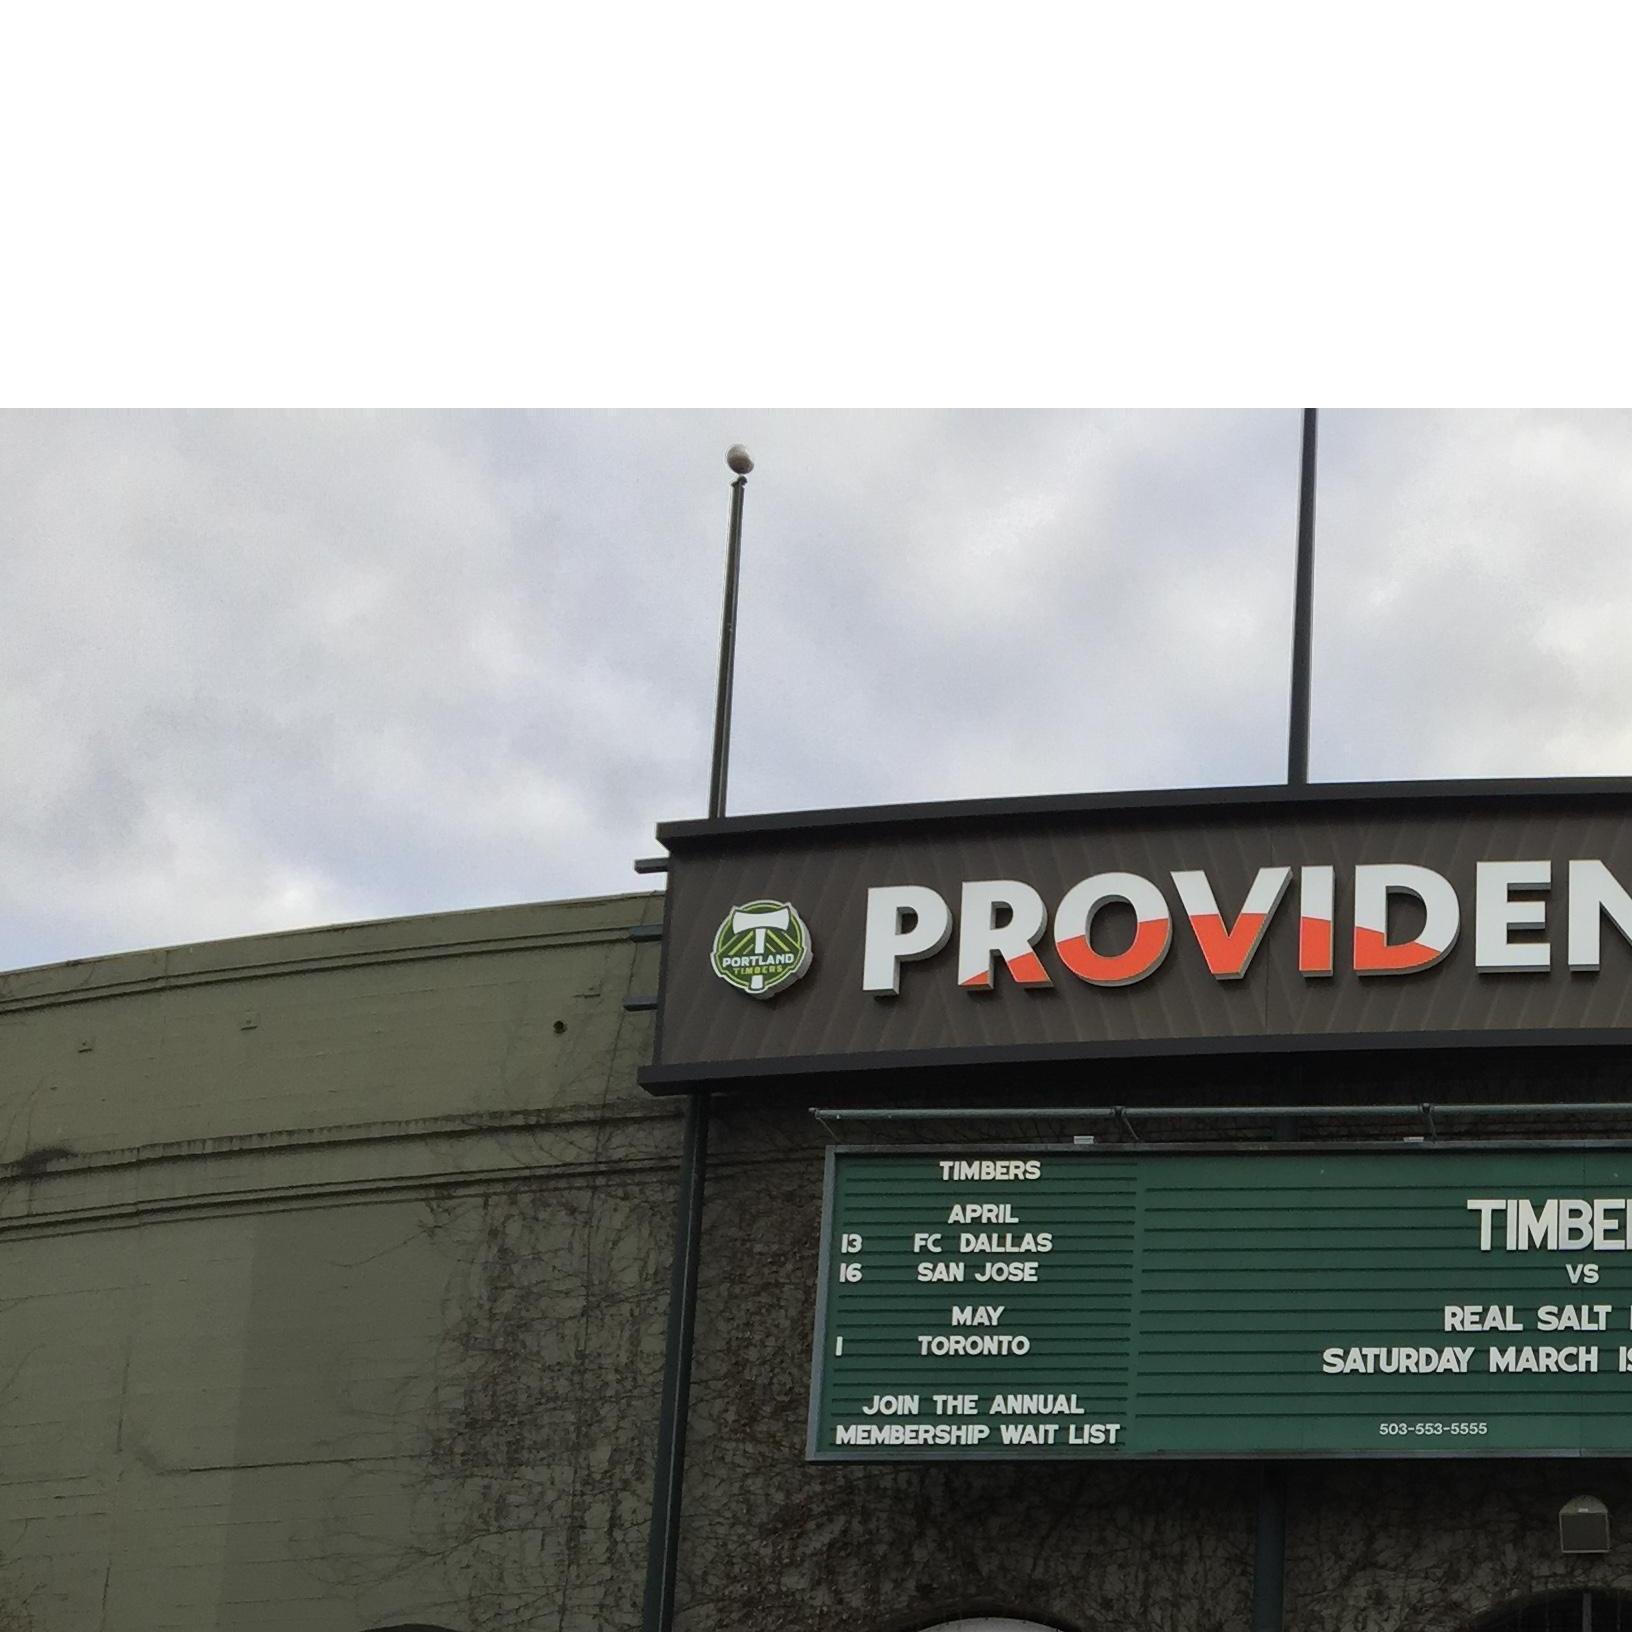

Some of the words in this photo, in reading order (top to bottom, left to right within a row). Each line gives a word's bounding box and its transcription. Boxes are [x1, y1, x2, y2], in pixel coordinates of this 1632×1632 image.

[722, 953, 794, 968] PORTLAND
[733, 964, 783, 975] TIMBERS
[939, 1160, 1041, 1181] TIMBERS
[947, 1203, 1020, 1224] APRIL
[841, 1233, 863, 1254] 13
[913, 1233, 942, 1254] FC
[959, 1232, 1053, 1253] DALLAS
[839, 1262, 863, 1283] 16
[917, 1262, 965, 1283] SAN
[974, 1261, 1039, 1282] JOSE
[1565, 1263, 1600, 1285] VS
[951, 1306, 1005, 1326] MAY
[1444, 1304, 1524, 1333] REAL
[1536, 1304, 1612, 1332] SALT
[917, 1335, 1031, 1356] TORONTO
[1322, 1346, 1476, 1375] SATURDAY
[1488, 1345, 1599, 1374] MARCH
[862, 1394, 919, 1416] JOIN
[932, 1394, 978, 1416] THE
[989, 1394, 1085, 1415] ANNUAL
[835, 1424, 991, 1446] MEMBERSHIP
[999, 1423, 1059, 1445] WAIT
[1068, 1423, 1121, 1445] LIST
[1378, 1421, 1488, 1436] 503-553-5555
